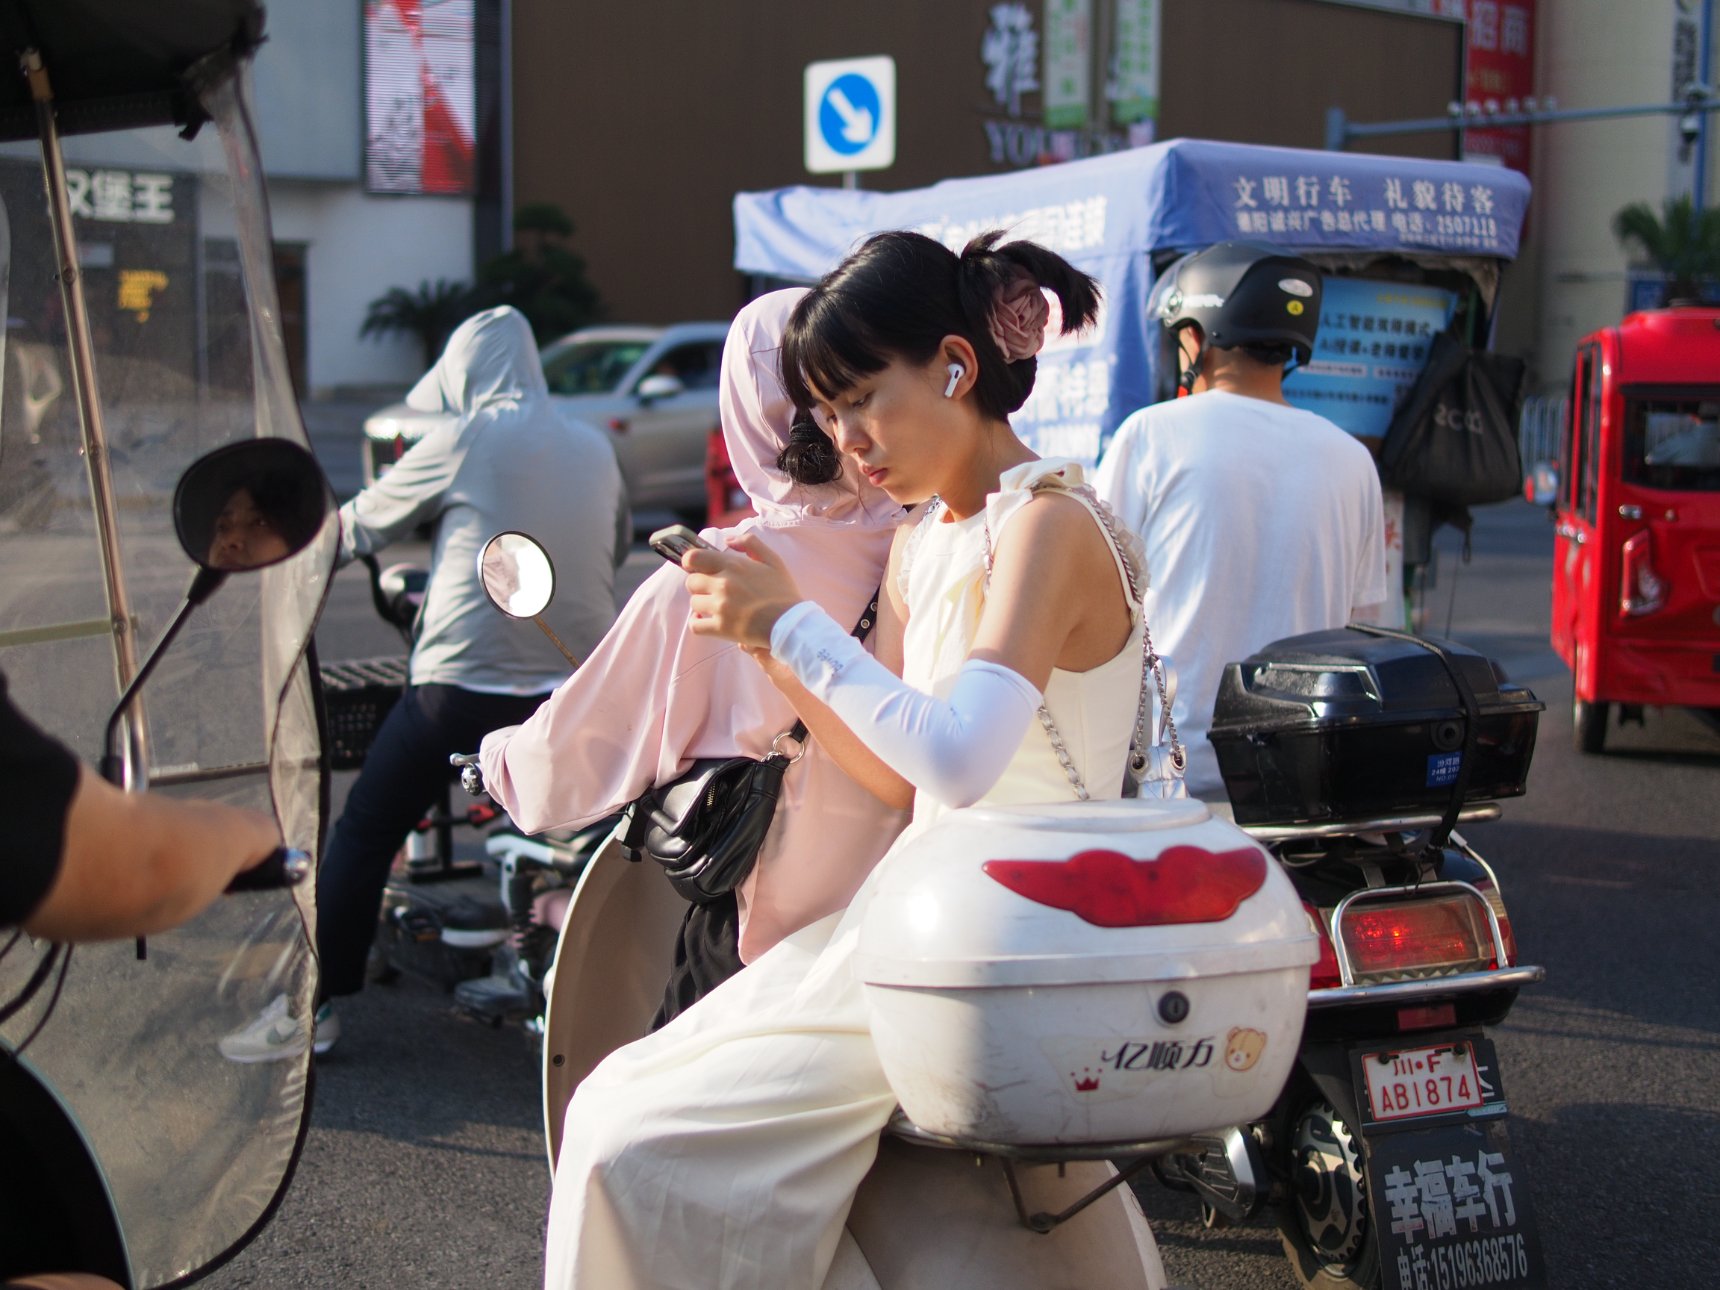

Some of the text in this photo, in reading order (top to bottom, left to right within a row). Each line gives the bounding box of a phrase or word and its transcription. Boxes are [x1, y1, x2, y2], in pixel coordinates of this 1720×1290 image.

[1233, 176, 1495, 215] 文明行车 礼貌待客
[1101, 1035, 1217, 1071] 亿顺力
[1381, 1075, 1471, 1113] AB1874
[1384, 1149, 1517, 1244] 幸福车行
